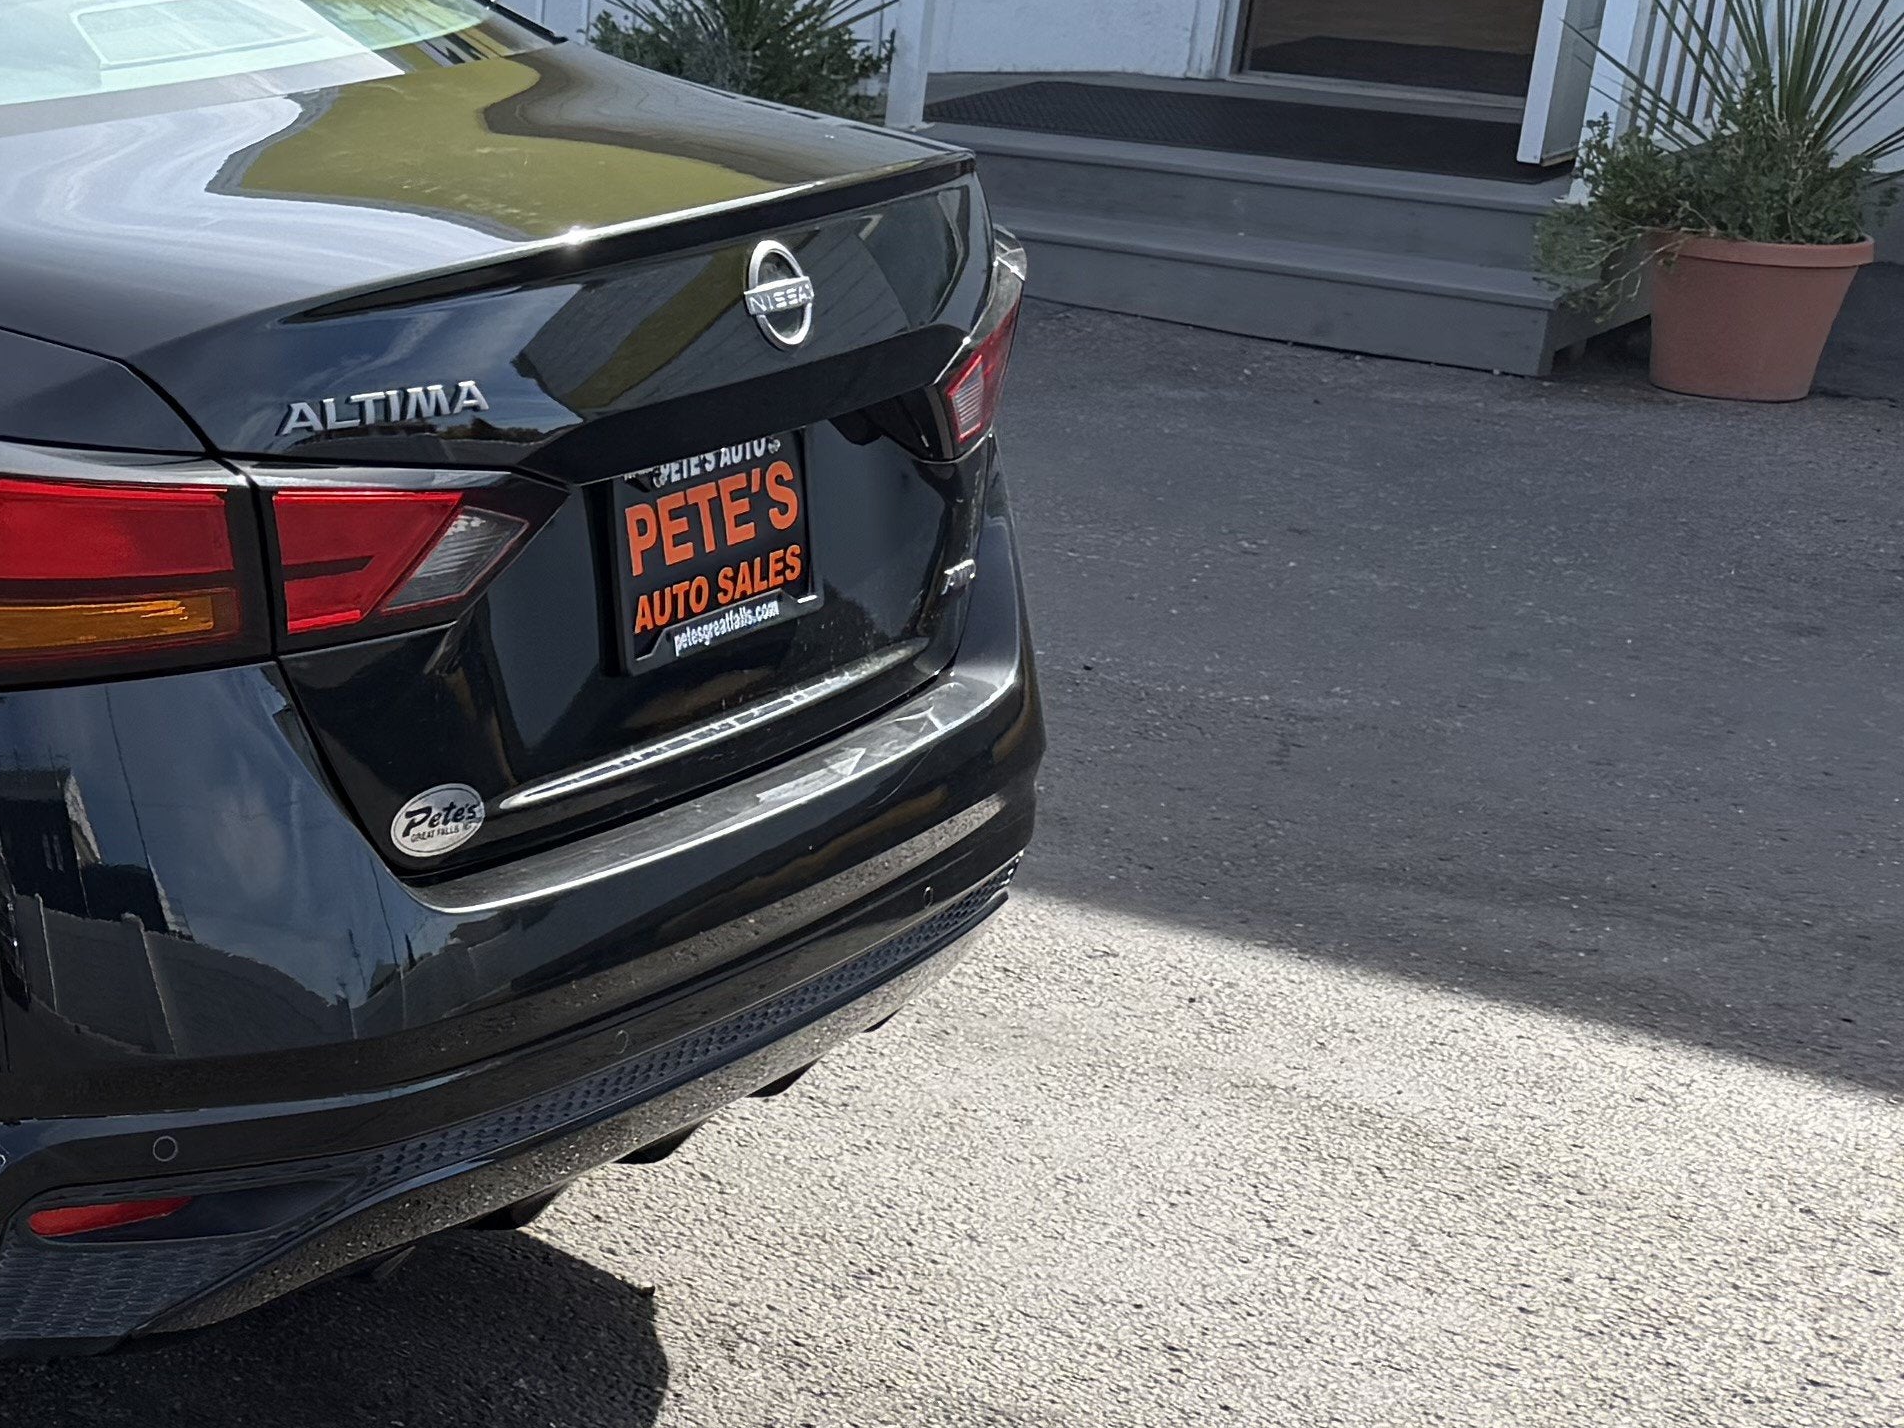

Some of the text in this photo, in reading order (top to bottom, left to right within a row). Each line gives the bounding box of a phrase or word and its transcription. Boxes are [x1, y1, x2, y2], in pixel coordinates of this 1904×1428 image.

[276, 380, 490, 437] ALTIMA
[624, 460, 798, 577] PETE'S
[634, 544, 802, 635] AUTO SALES
[402, 801, 480, 838] Pete's
